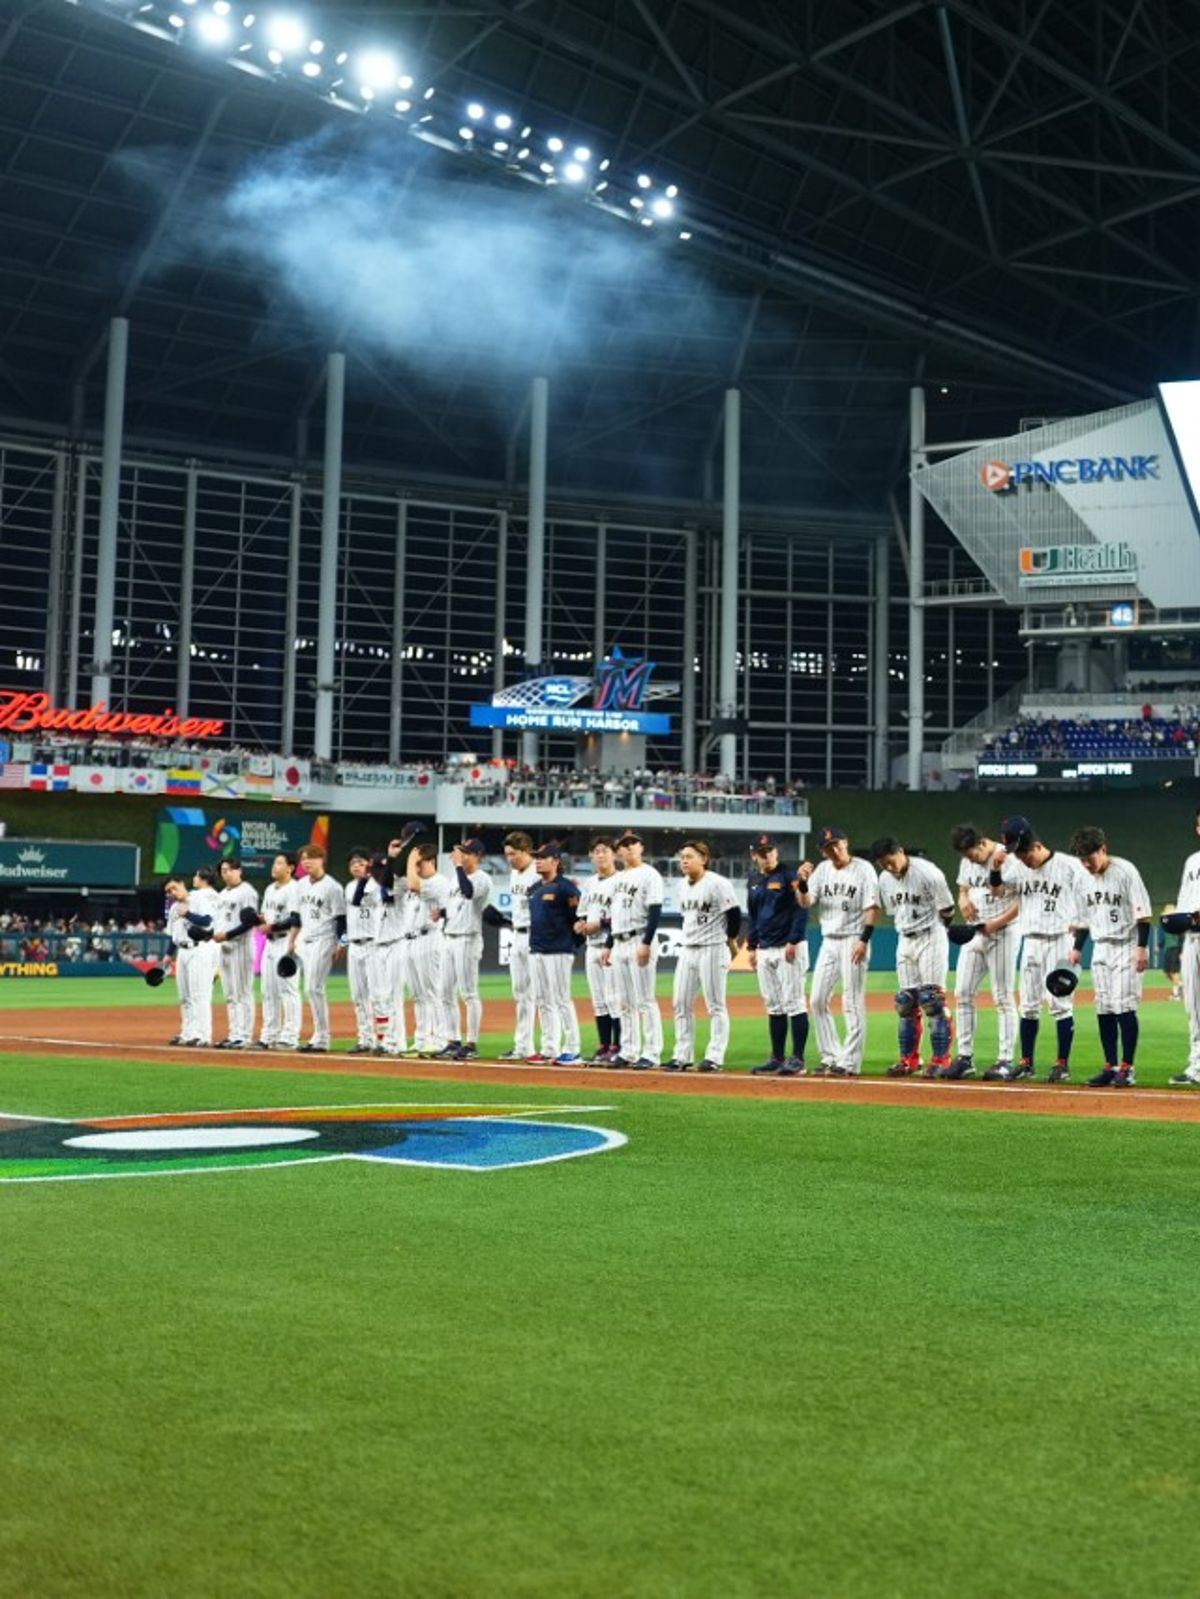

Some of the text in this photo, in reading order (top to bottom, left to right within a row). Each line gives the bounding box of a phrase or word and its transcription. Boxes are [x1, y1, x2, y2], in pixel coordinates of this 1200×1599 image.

[0, 690, 224, 737] Budweiser
[506, 714, 640, 731] HOME RUN HARBOR
[1107, 762, 1133, 775] TYPE
[241, 820, 276, 831] WORLD
[240, 830, 288, 841] BASEBALL
[240, 839, 282, 850] CLASSIC
[1043, 899, 1057, 912] 27
[1109, 909, 1119, 923] 5
